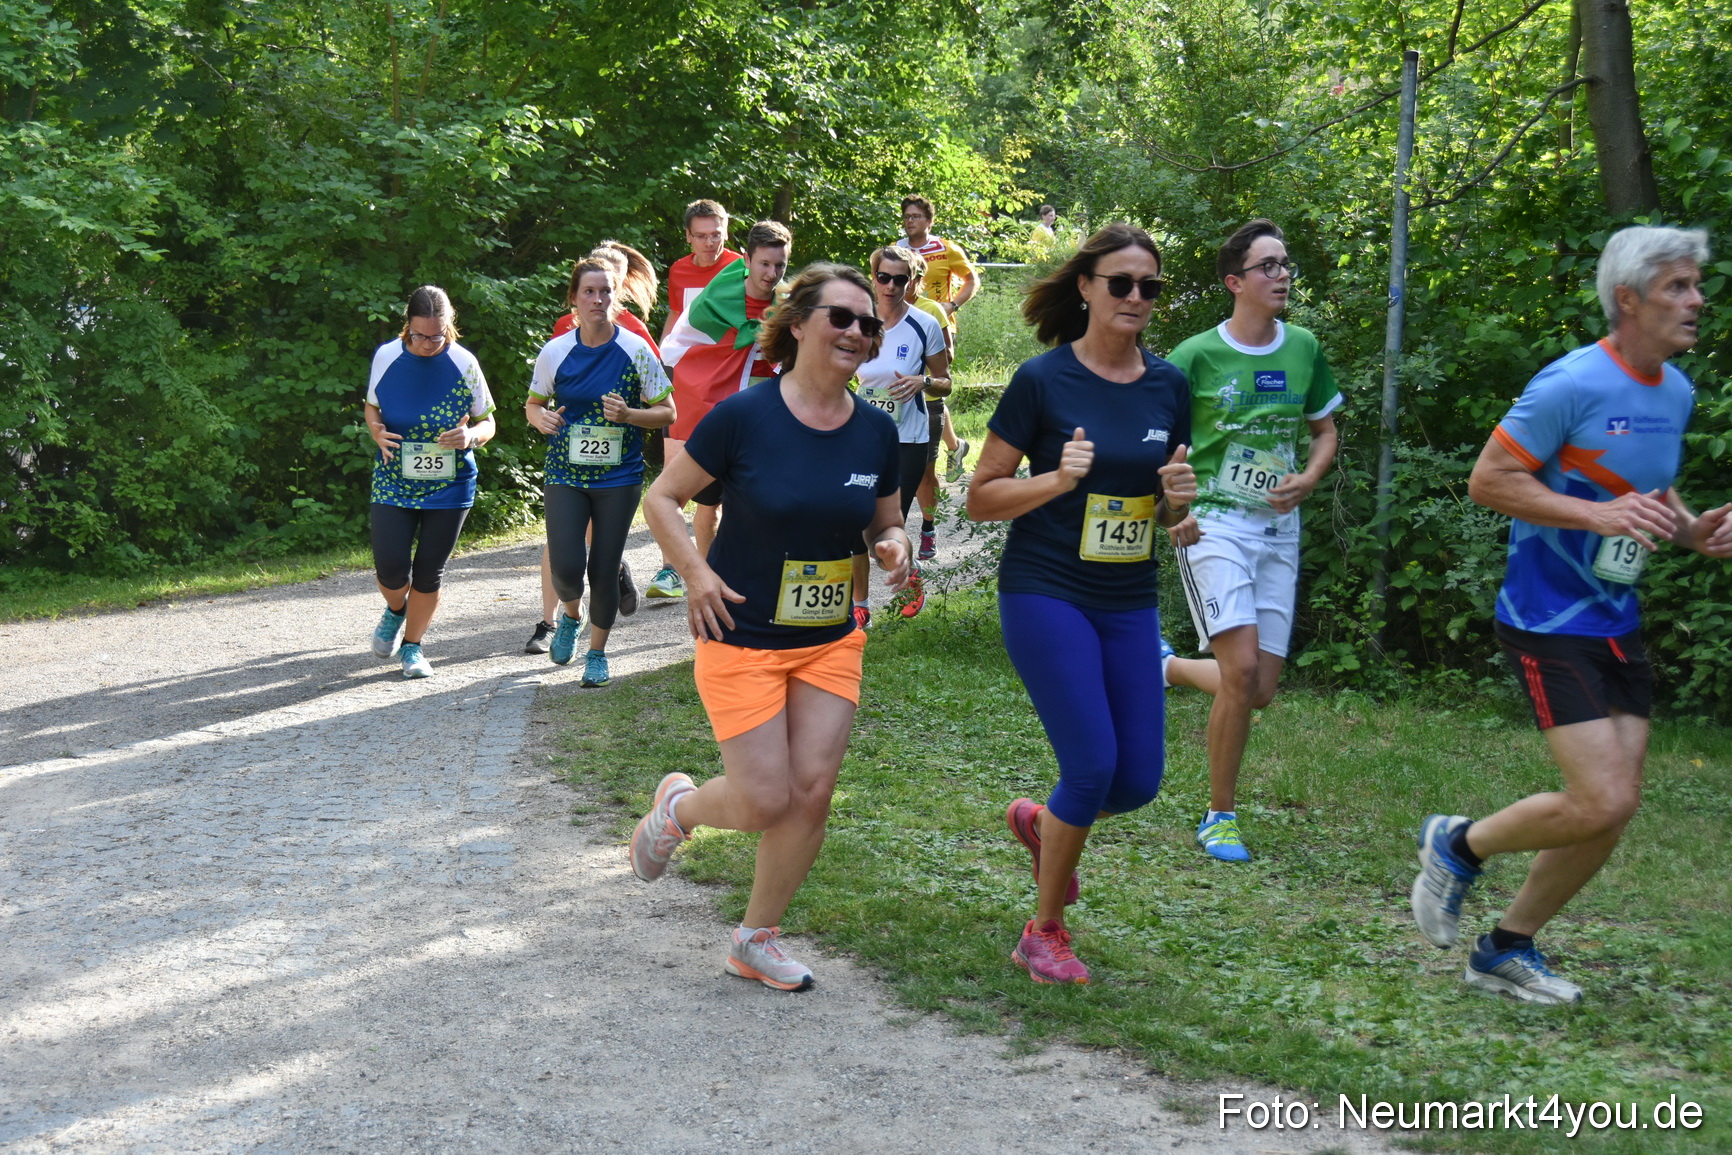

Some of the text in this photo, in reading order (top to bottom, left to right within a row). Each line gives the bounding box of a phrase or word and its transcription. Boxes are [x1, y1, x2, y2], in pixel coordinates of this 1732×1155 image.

[865, 399, 895, 414] 79
[1240, 389, 1306, 405] firmenlau
[580, 440, 610, 454] 223
[414, 456, 443, 469] 235
[1230, 463, 1278, 492] 1190
[1096, 520, 1148, 544] 1437
[1612, 538, 1639, 565] 19
[791, 583, 845, 608] 1395
